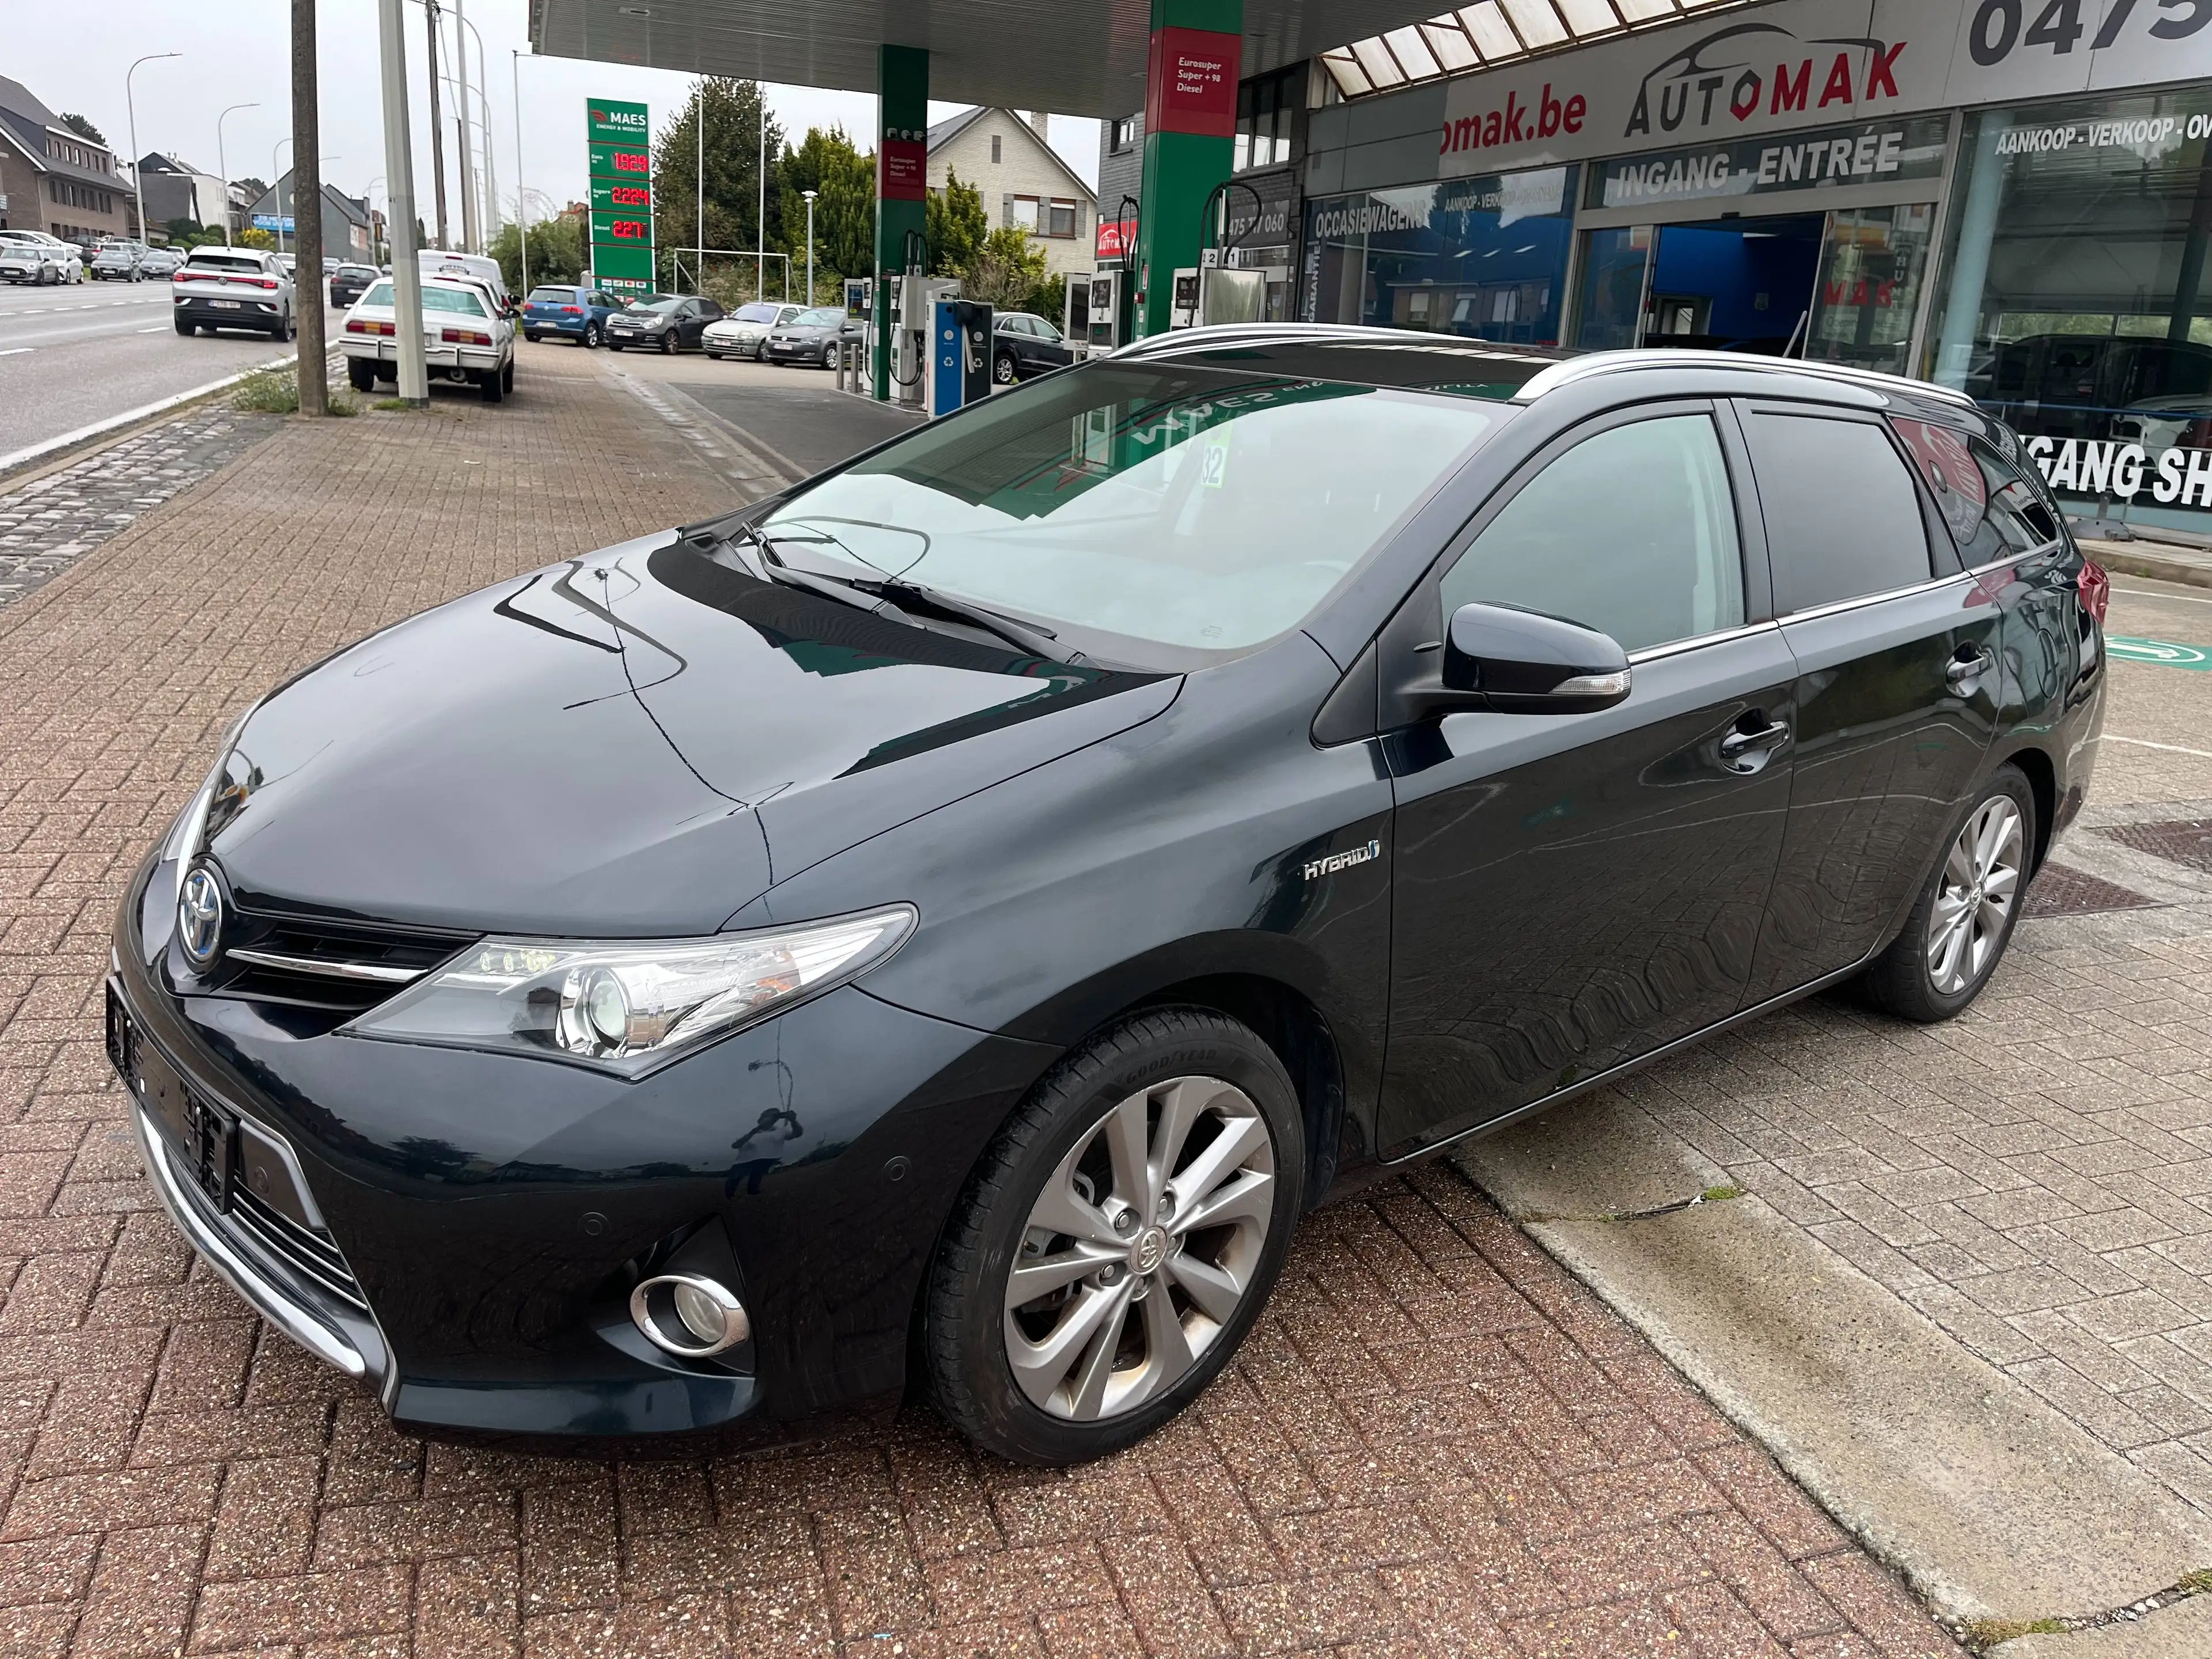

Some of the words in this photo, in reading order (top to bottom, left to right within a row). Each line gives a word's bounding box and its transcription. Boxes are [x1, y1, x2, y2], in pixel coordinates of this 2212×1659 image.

[1177, 69, 1203, 81] Super
[1211, 74, 1221, 82] 98
[1178, 57, 1221, 71] Eurosuper
[1176, 82, 1203, 93] Diesel
[1623, 41, 1908, 138] AUTOMAK
[610, 112, 646, 126] MAES
[1995, 127, 2076, 156] AANKOOP
[2088, 118, 2175, 147] VERKOOP
[1617, 153, 1730, 199] INGANG
[1757, 126, 1903, 185] ENTRÉE
[1444, 195, 1478, 213] AANKOOP
[1264, 213, 1285, 233] 060
[1316, 199, 1427, 238] OCCASIEWAGENS
[1209, 253, 1215, 263] 2
[1230, 253, 1235, 262] 1
[1308, 245, 1321, 323] GARANTIE
[1203, 446, 1222, 484] 32
[2018, 435, 2146, 498] GANG
[1304, 846, 1370, 881] HYBRID
